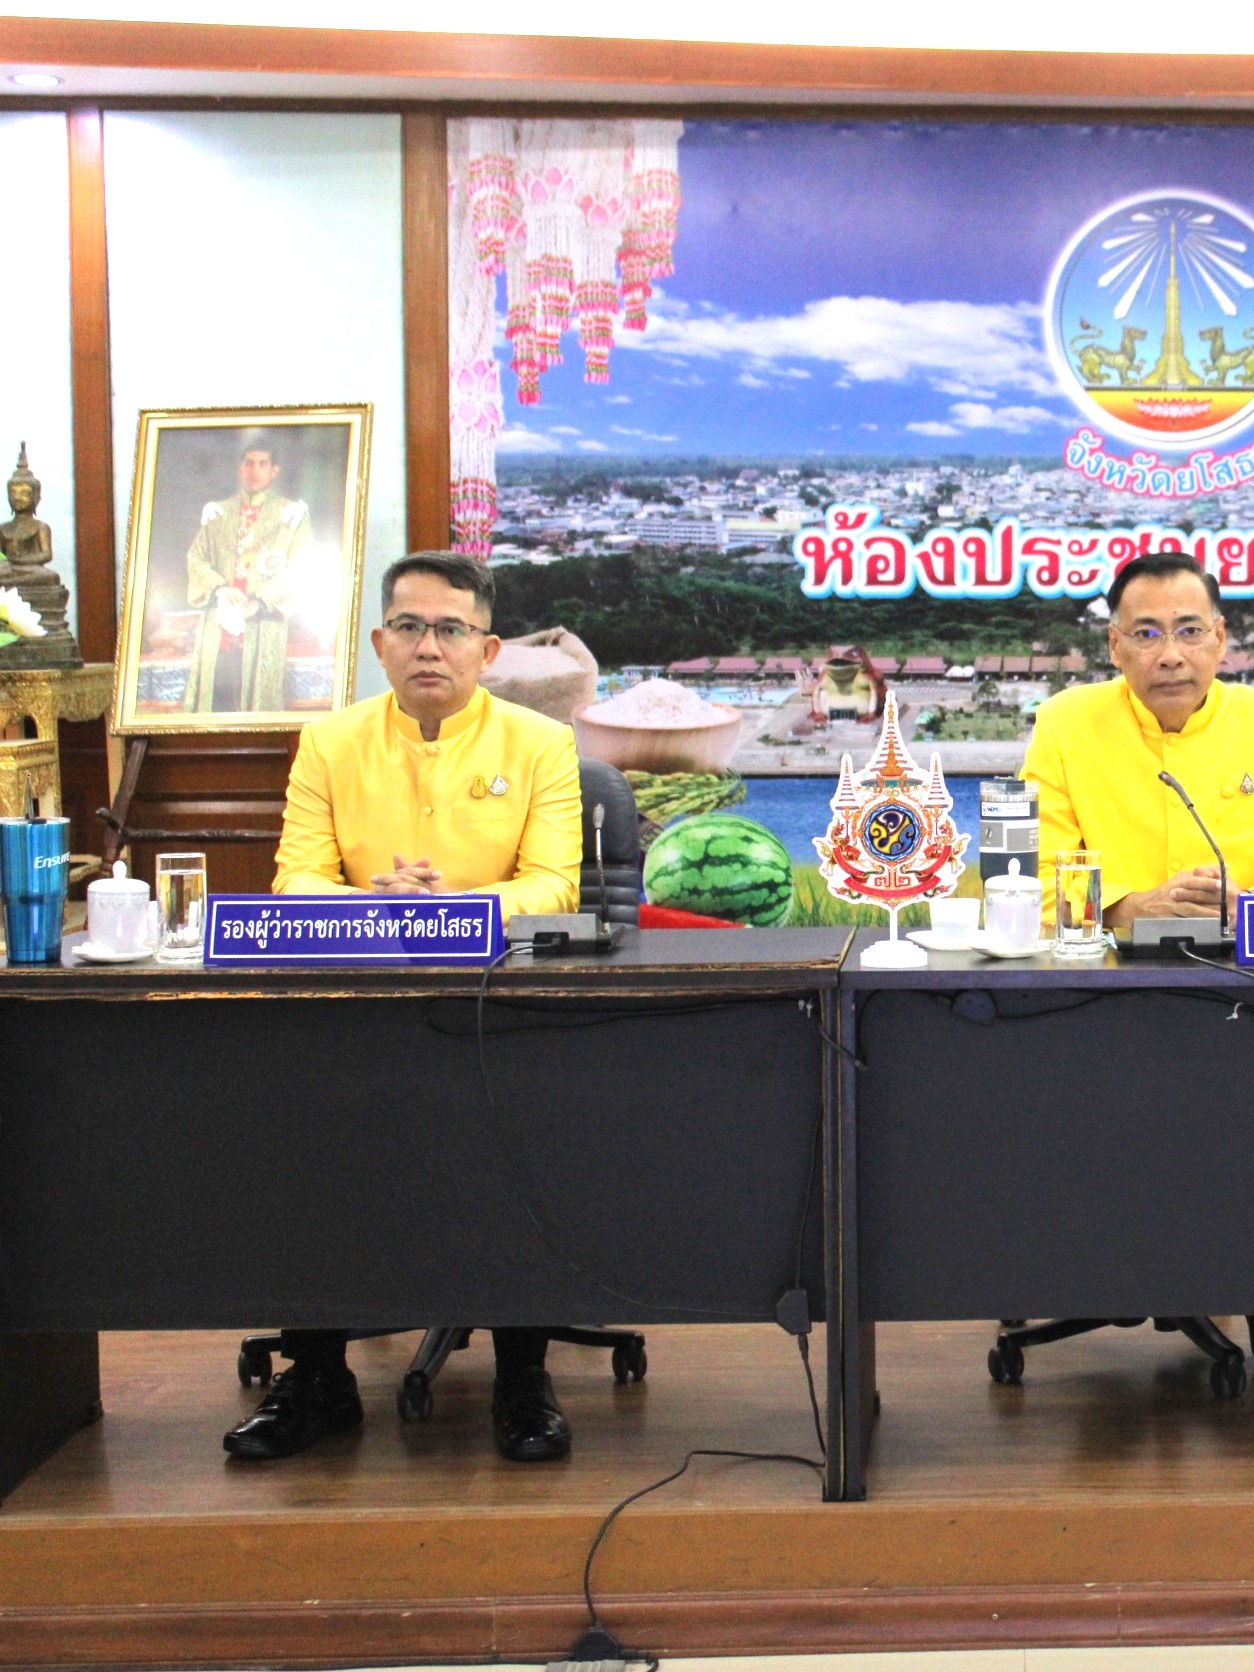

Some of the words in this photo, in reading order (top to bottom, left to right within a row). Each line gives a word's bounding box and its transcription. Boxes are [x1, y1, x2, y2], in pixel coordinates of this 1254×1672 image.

[221, 909, 483, 949] รองผู้ว่าราชการจังหวัดยโสธร
